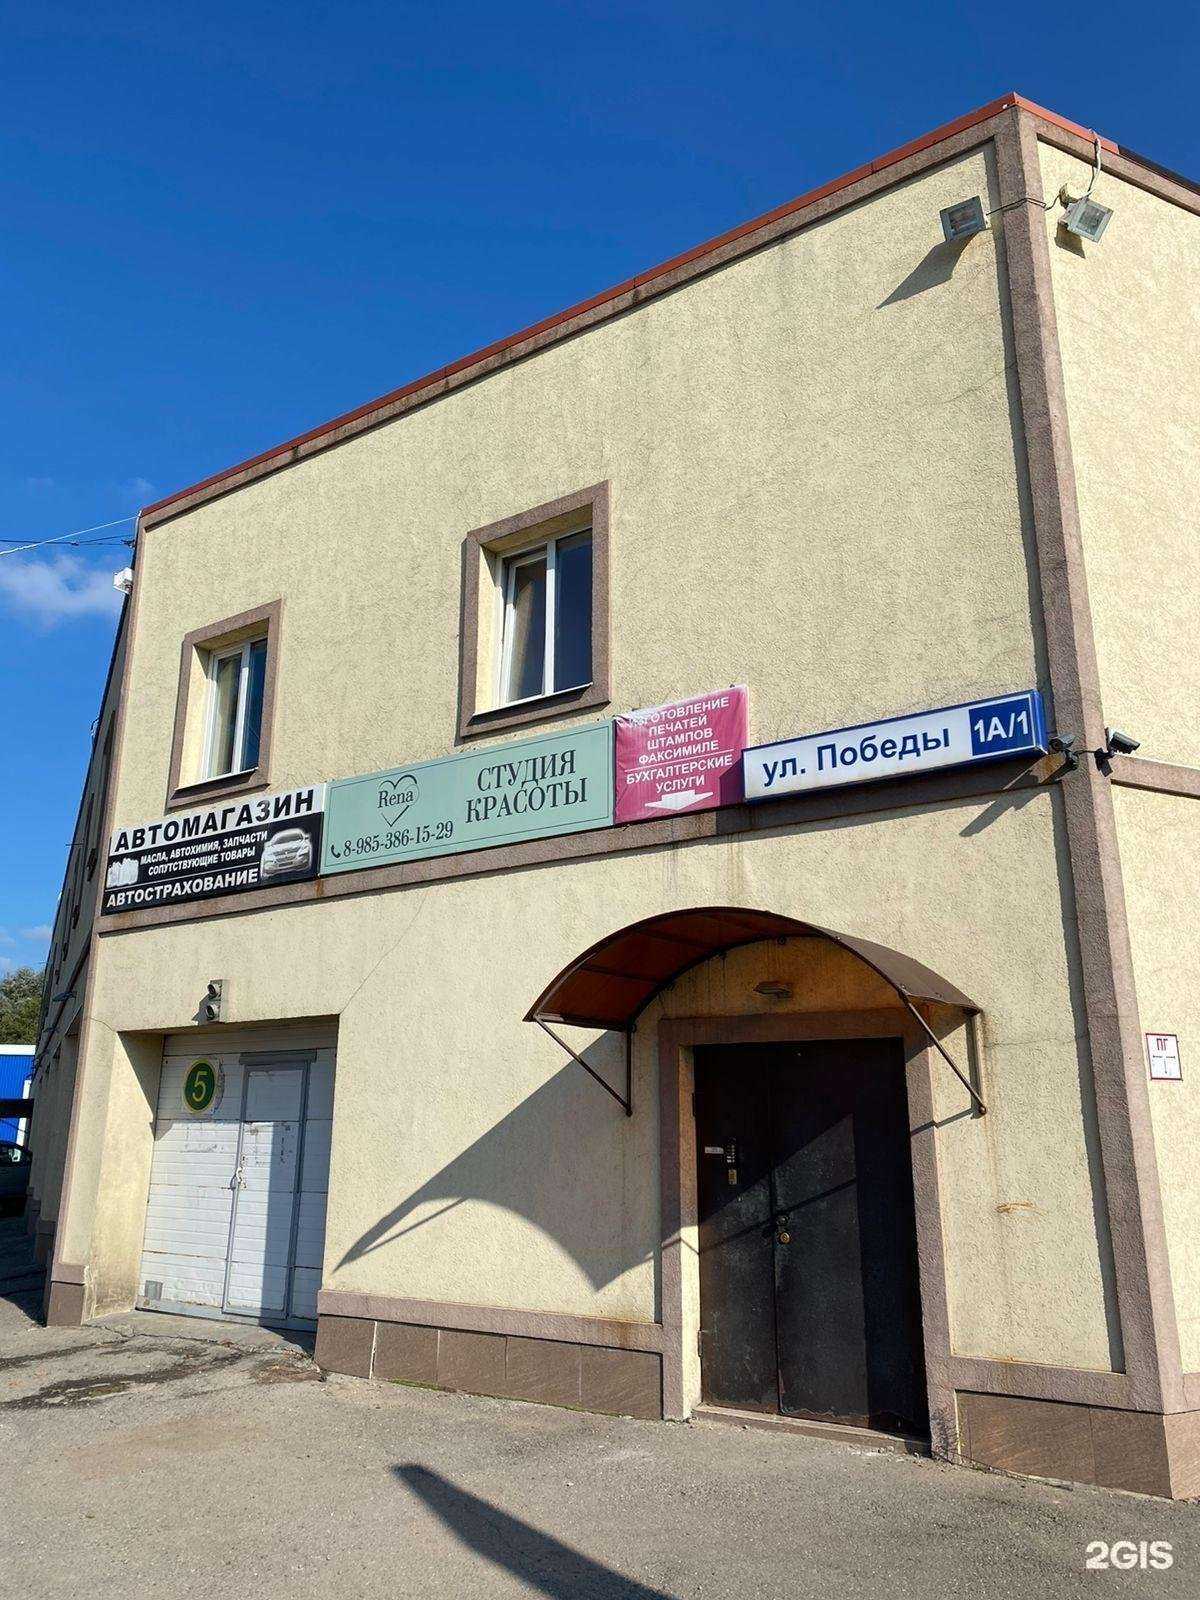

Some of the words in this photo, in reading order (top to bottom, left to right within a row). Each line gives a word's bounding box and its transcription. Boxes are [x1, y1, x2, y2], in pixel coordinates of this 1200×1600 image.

[647, 728, 713, 750] ШТАМПОВ
[649, 713, 707, 737] ПЕЧАТЕЙ
[973, 710, 1029, 743] 1А/1
[638, 740, 719, 765] ФАКСИМИЛЕ
[762, 758, 806, 787] ул.
[817, 728, 950, 770] Победы
[477, 750, 576, 792] СТУДИЯ
[626, 754, 732, 785] БУХГАЛТЕРСКИЕ
[656, 775, 705, 793] УСЛУГИ
[377, 790, 414, 808] Rena
[465, 778, 588, 824] КРАСОТЫ
[114, 789, 314, 853] АВТОМАГАЗИН
[140, 852, 169, 866] МАСЛА,
[170, 839, 221, 860] АВТОХИМИЯ,
[223, 829, 268, 849] ЗАПЧАСТИ
[343, 820, 454, 858] 8-985-386-15-29
[148, 855, 219, 876] СОПУТСТВУЮЩИЕ
[220, 846, 256, 862] ТОВАРЫ
[106, 868, 259, 908] АВТОСТРАХОВАНИЕ
[192, 1071, 208, 1102] 5
